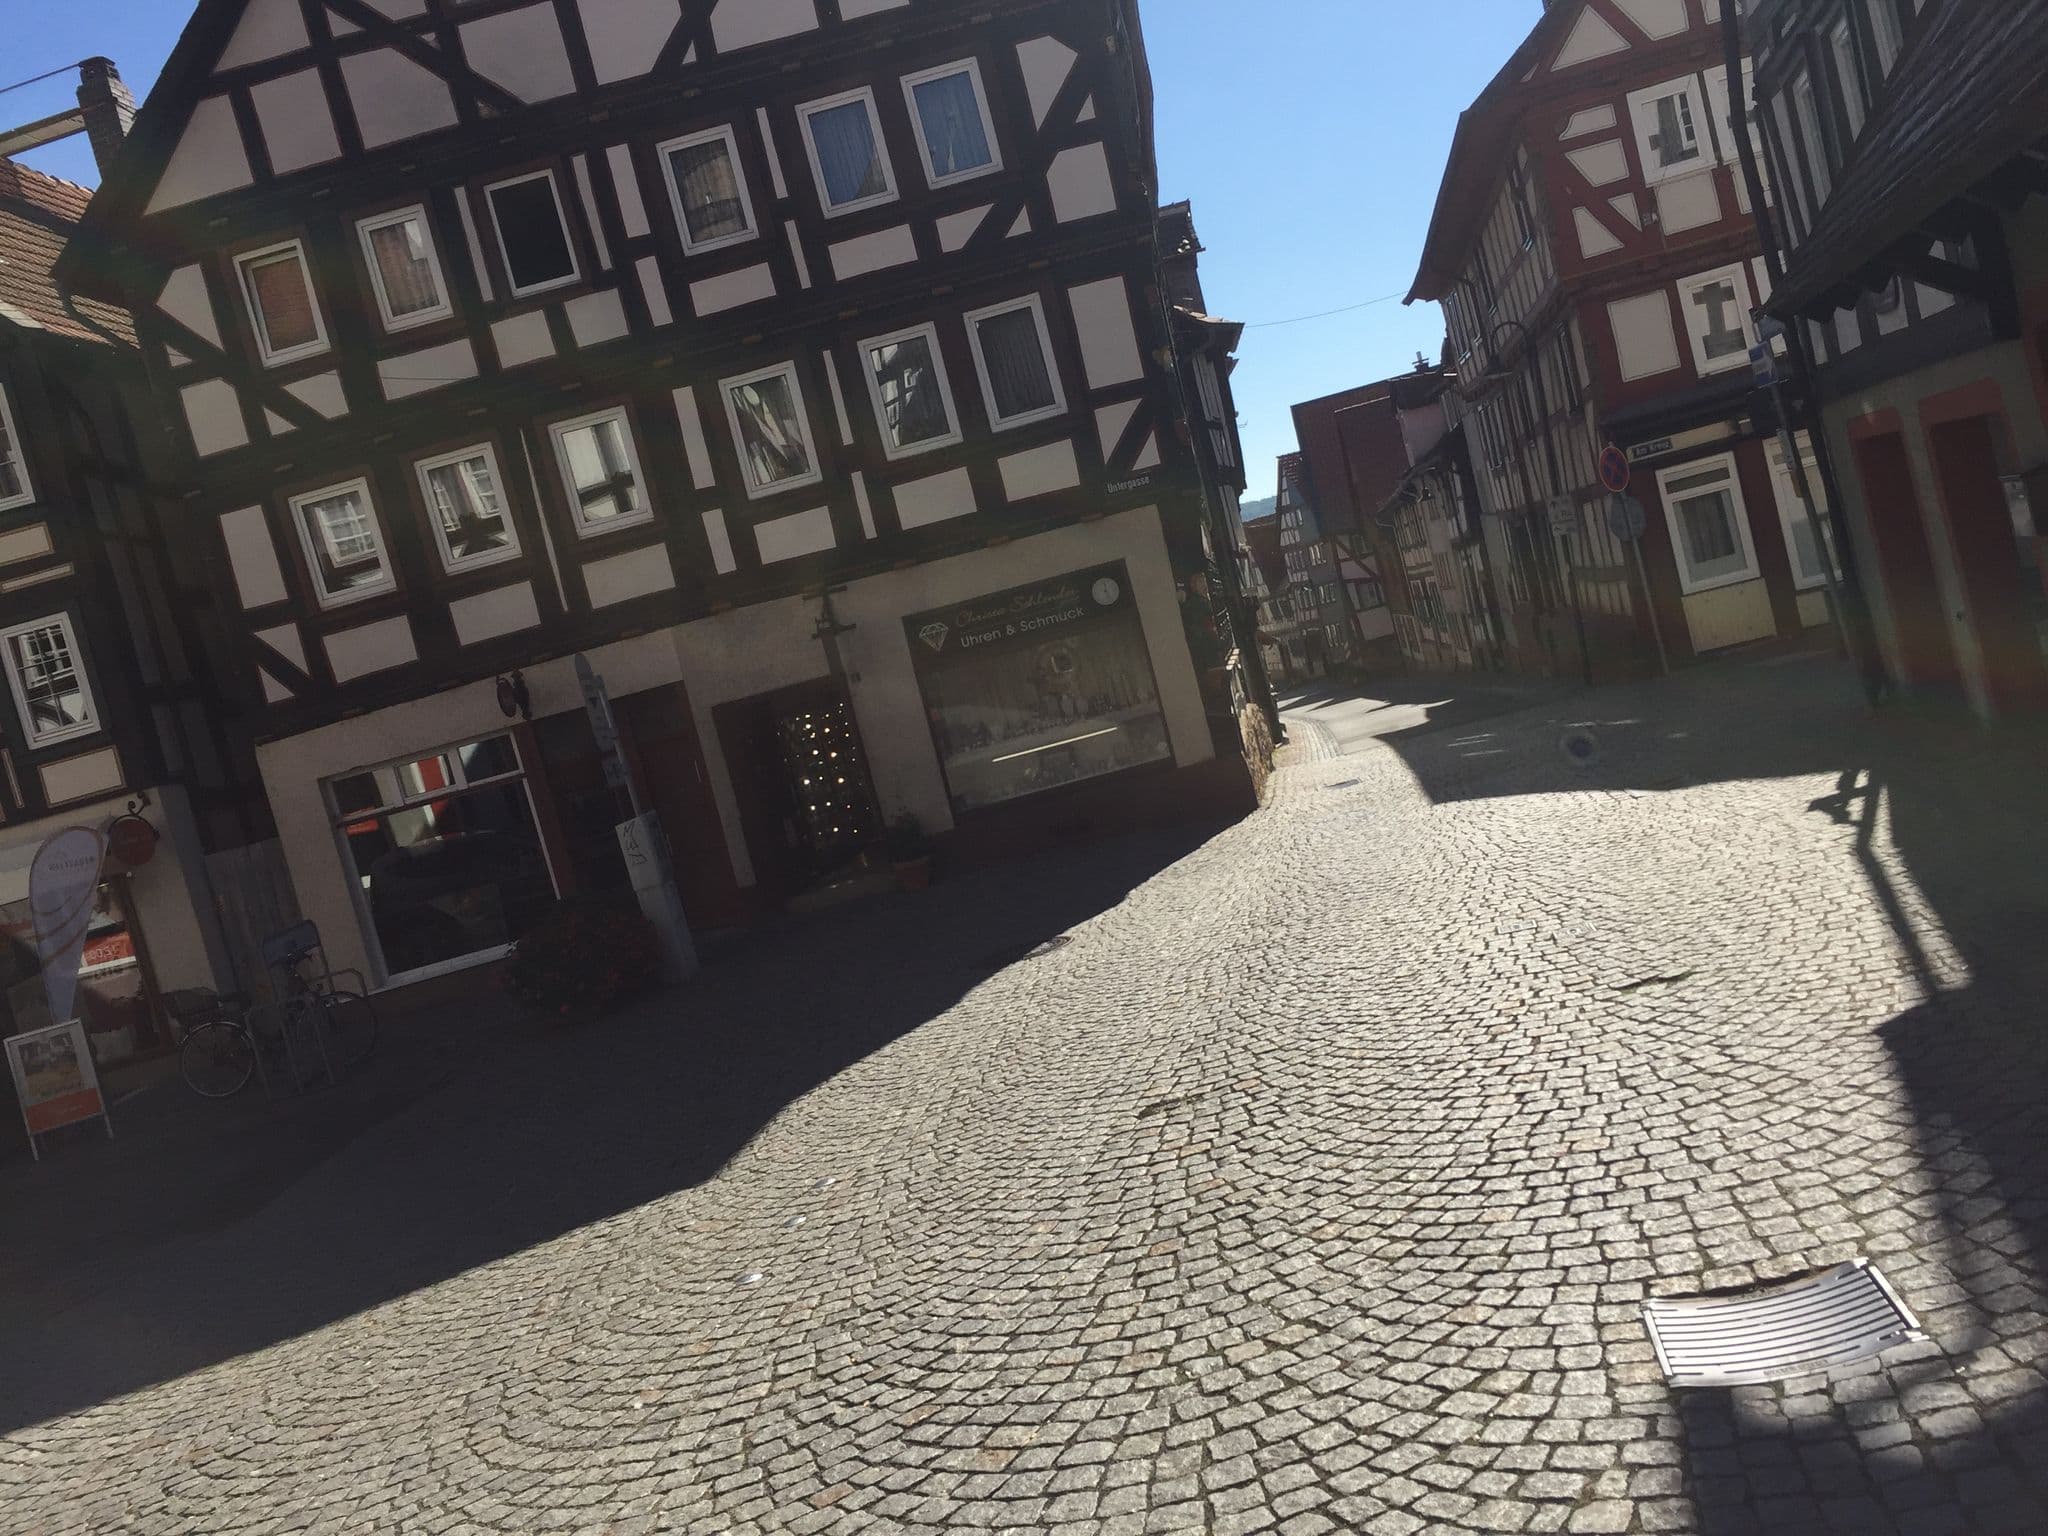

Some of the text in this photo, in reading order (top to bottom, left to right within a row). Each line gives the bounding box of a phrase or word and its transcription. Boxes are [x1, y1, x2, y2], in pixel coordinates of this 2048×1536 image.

[1107, 476, 1150, 494] Untergasse
[960, 606, 1087, 649] Uhren & Schmuck
